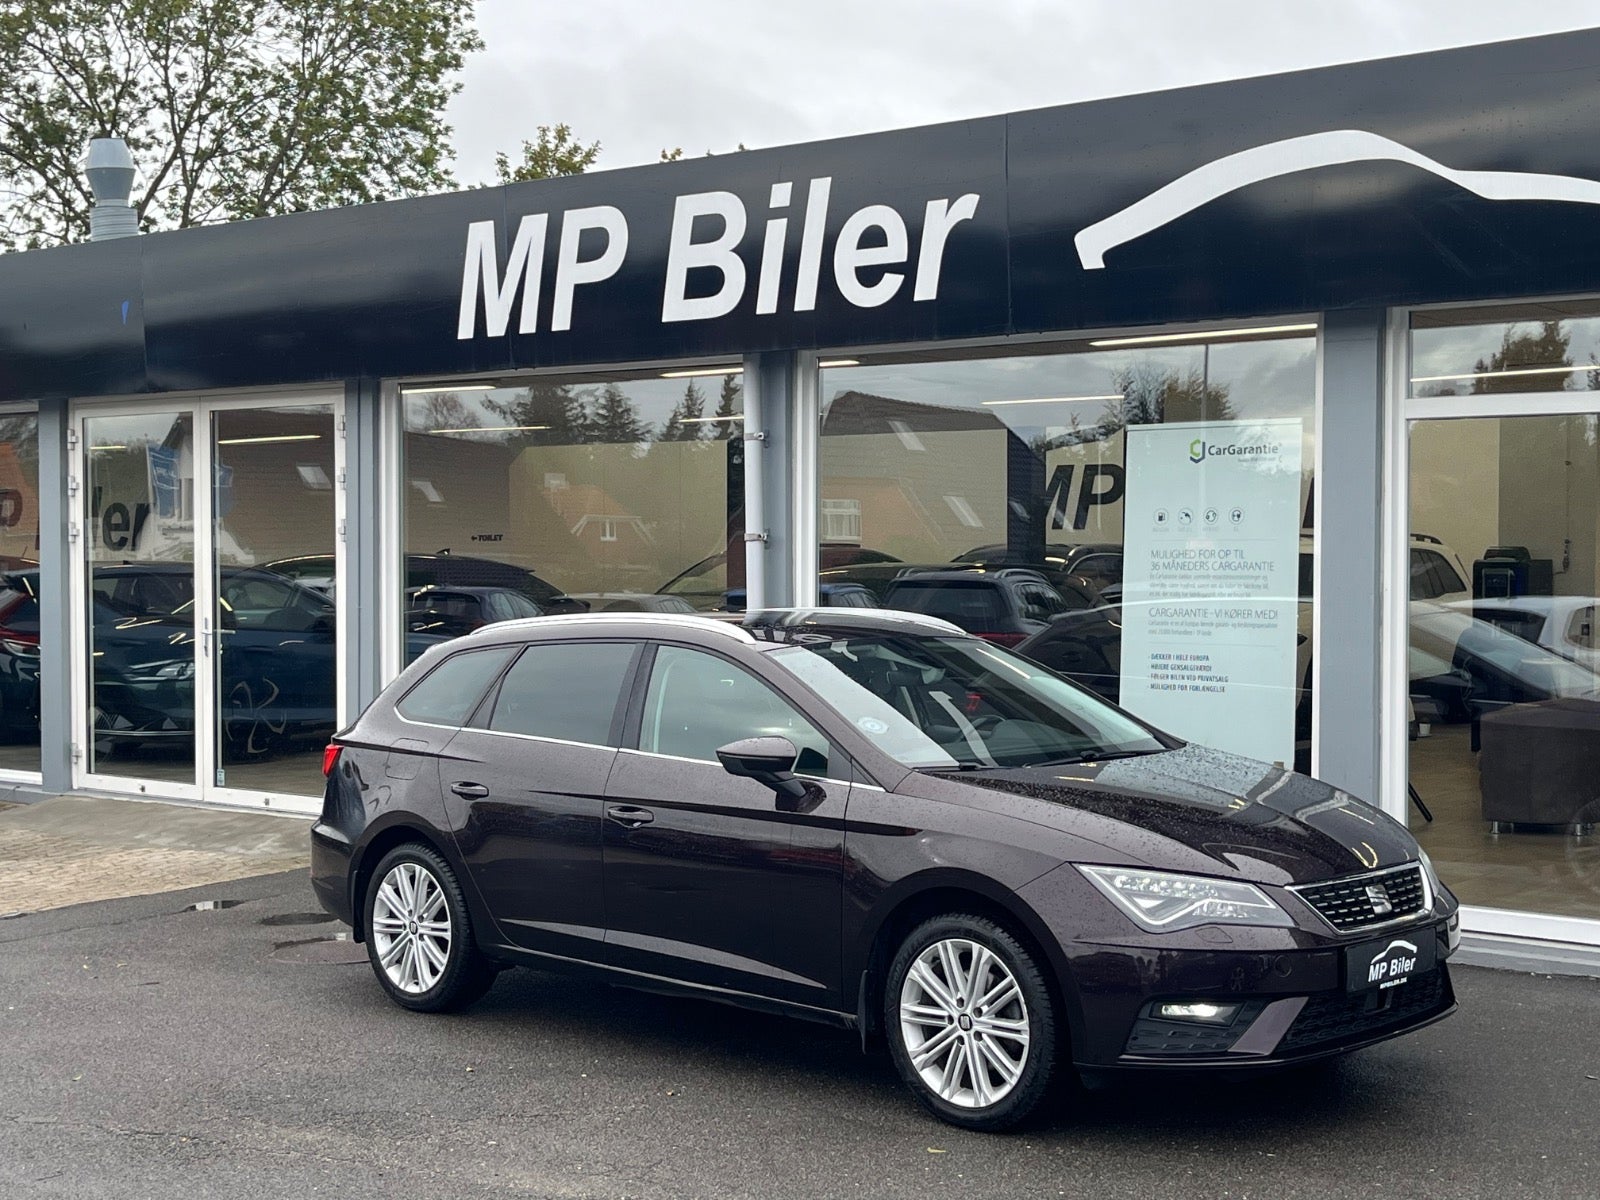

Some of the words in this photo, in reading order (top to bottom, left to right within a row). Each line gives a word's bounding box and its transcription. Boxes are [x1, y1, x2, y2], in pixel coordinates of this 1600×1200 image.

[457, 205, 629, 340] MP
[661, 176, 980, 323] Biler
[1207, 443, 1279, 457] CarGarantie
[477, 533, 504, 542] TOILET
[1150, 549, 1196, 560] MULIGHED
[1198, 549, 1216, 560] FOR
[1217, 549, 1232, 560] OP
[1234, 549, 1246, 560] TIL
[1150, 561, 1161, 571] 36
[1162, 559, 1210, 571] MÅNEDERS
[1211, 561, 1275, 572] CARGARANTIE
[1148, 607, 1209, 618] CARGARANTIE
[1214, 608, 1223, 618] VI
[1224, 608, 1253, 619] KØRER
[1368, 962, 1388, 982] MP
[1389, 956, 1416, 976] Biler
